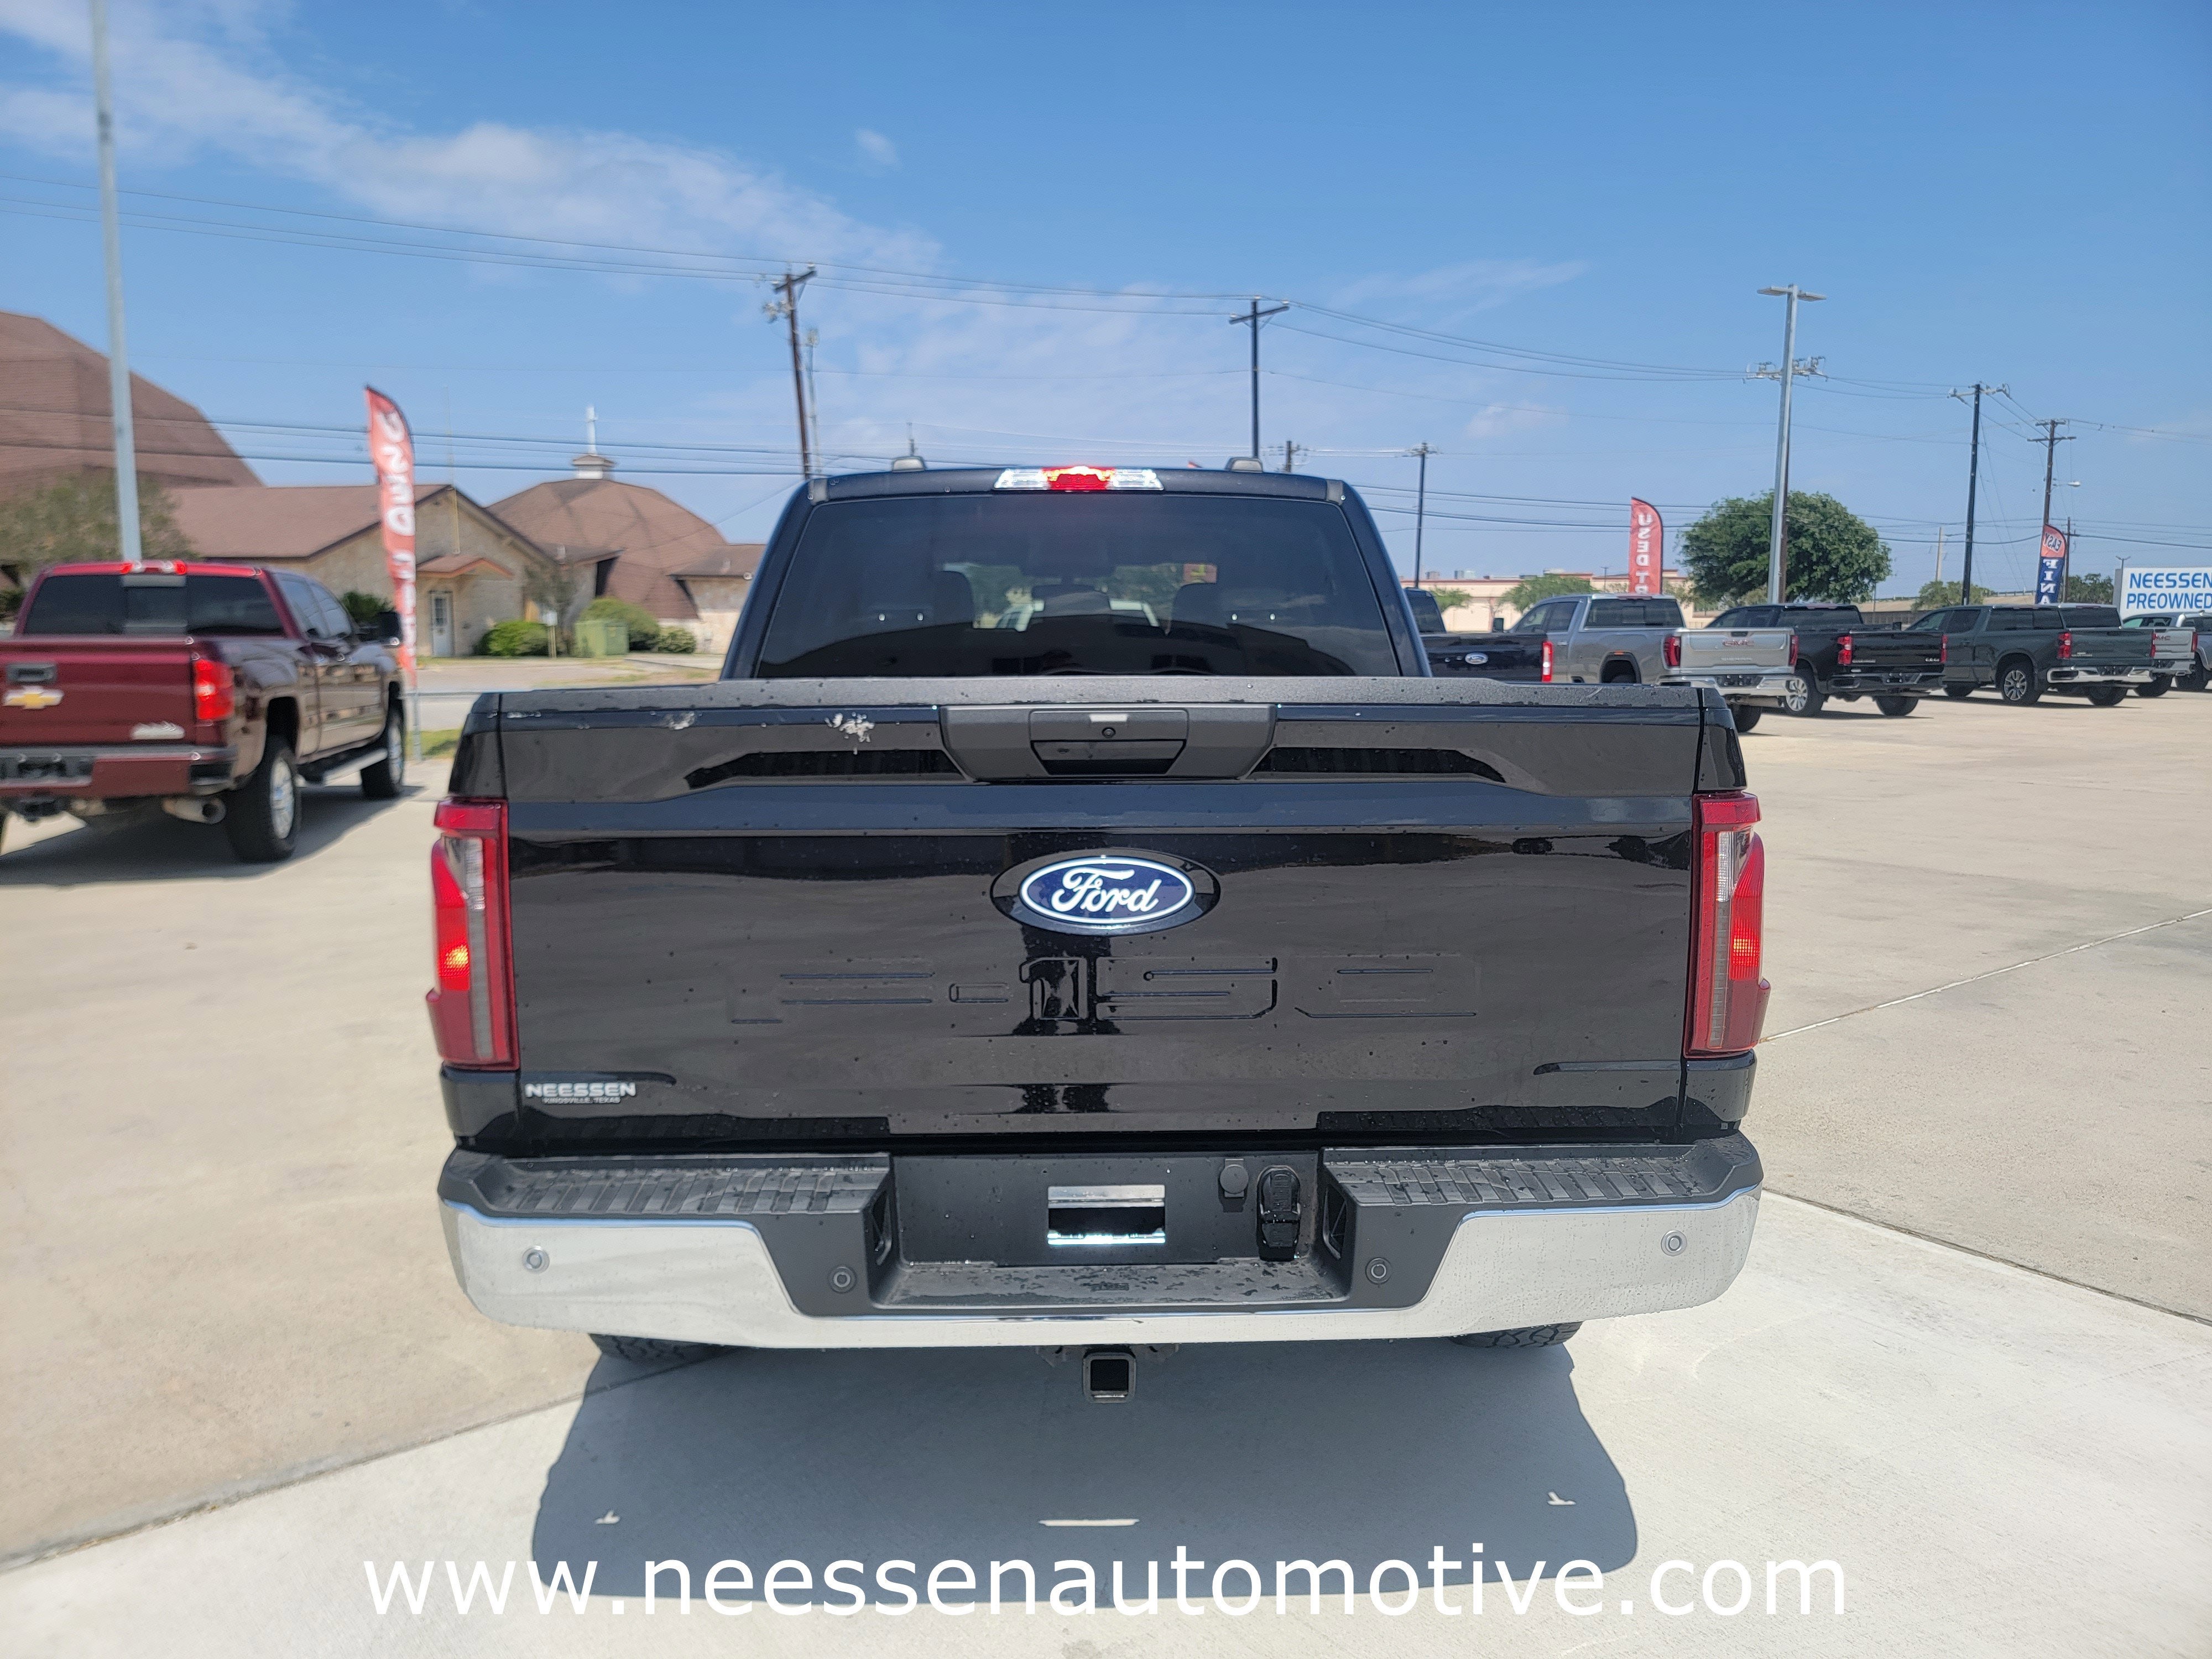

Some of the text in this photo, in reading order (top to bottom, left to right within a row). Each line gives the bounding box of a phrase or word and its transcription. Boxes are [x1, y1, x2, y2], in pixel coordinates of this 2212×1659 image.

[2129, 572, 2212, 589] NEESSEN
[2126, 593, 2212, 609] PREOWNED
[1051, 867, 1162, 912] Ford
[525, 1082, 637, 1098] NEESSEN
